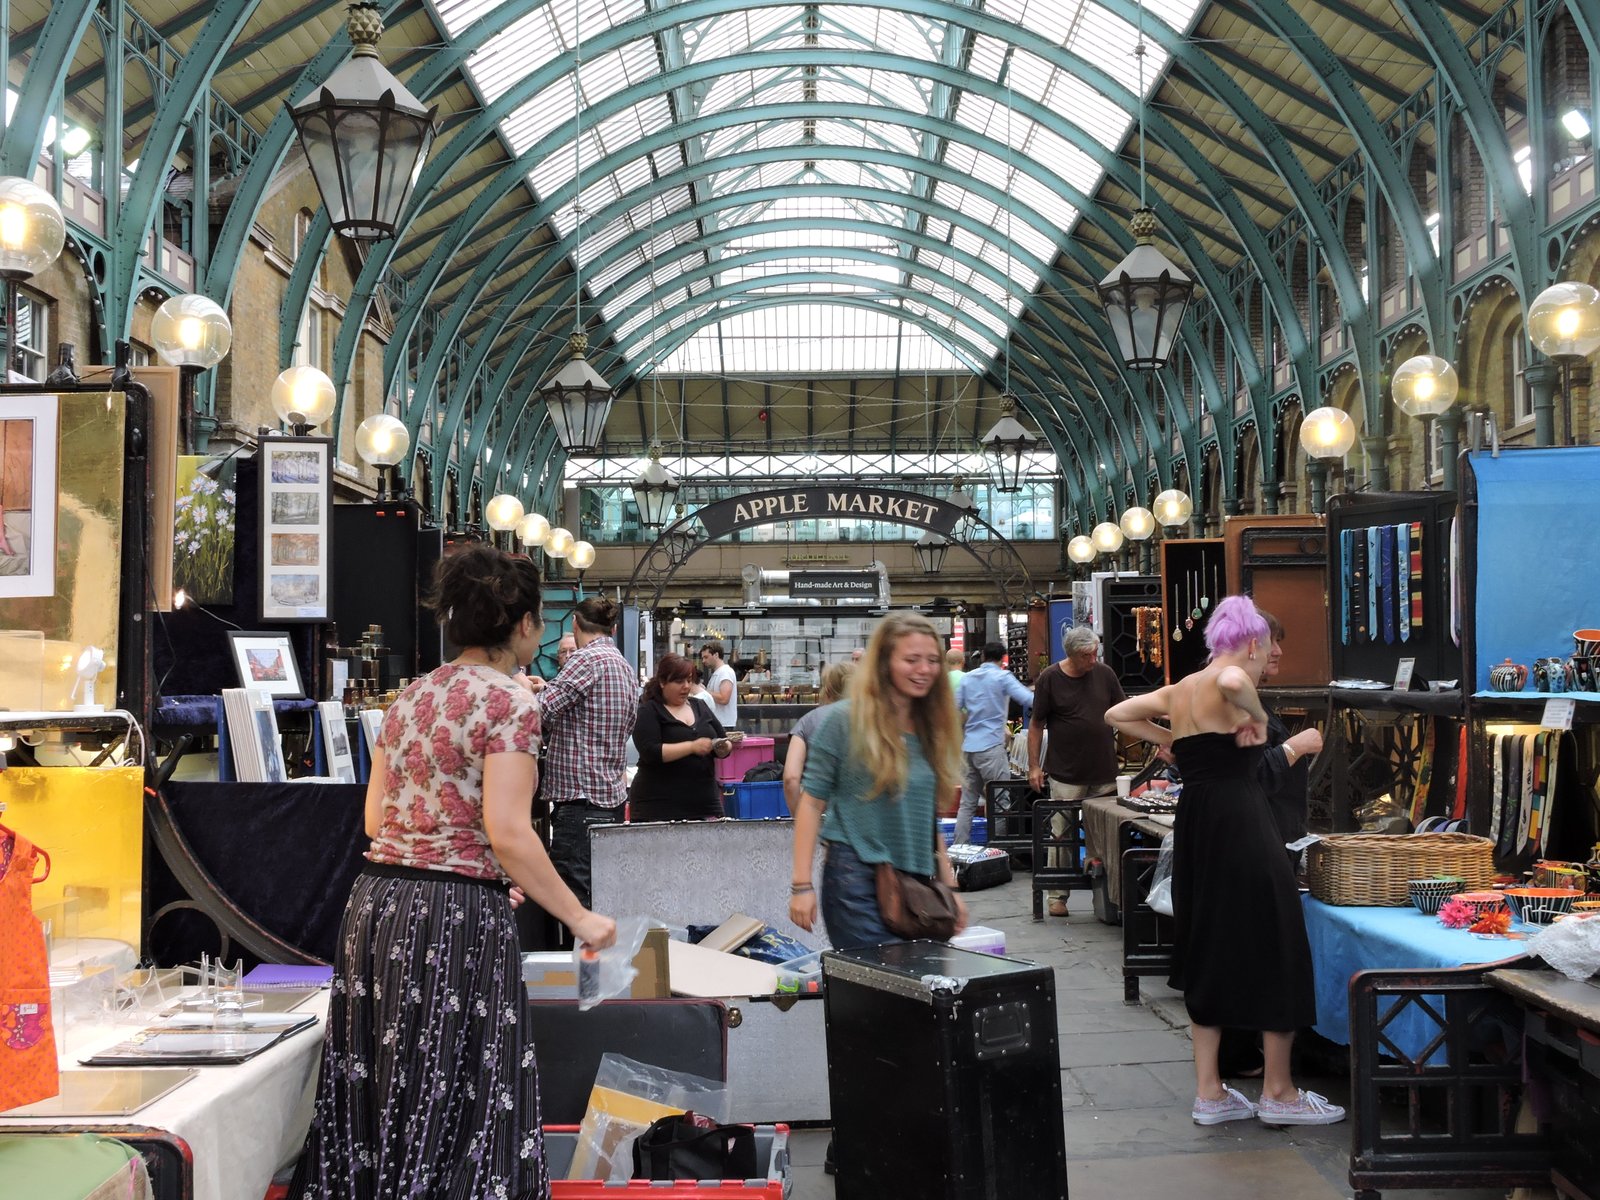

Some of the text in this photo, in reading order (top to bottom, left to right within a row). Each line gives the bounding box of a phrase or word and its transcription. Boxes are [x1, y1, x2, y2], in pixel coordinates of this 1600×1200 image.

[734, 493, 939, 524] APPLE MARKET
[794, 581, 873, 590] Hand-made Art & Design
